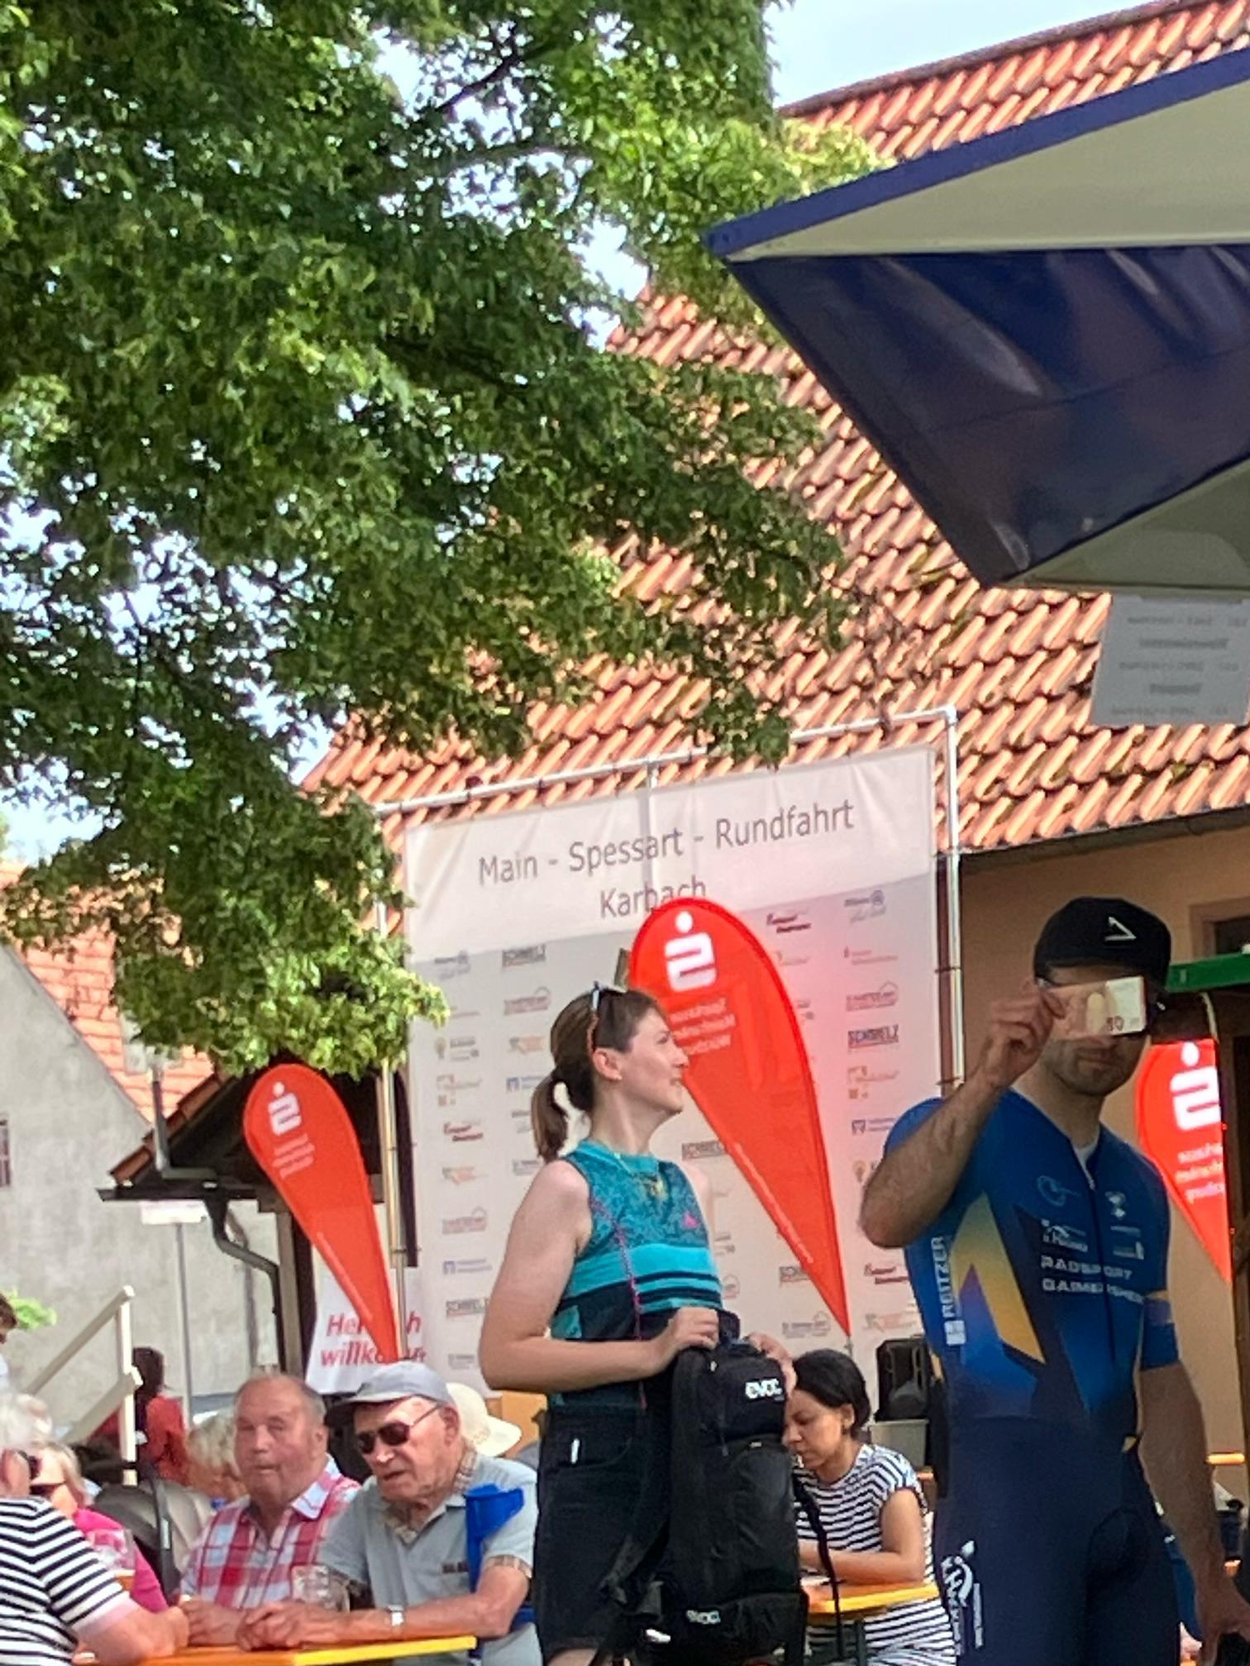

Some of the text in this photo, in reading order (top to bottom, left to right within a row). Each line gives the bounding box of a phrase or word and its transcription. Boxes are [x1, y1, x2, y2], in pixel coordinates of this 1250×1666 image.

[479, 852, 538, 886] Main
[568, 828, 684, 875] Spessart
[715, 799, 855, 849] Rundfahrt
[600, 874, 706, 918] Karbach
